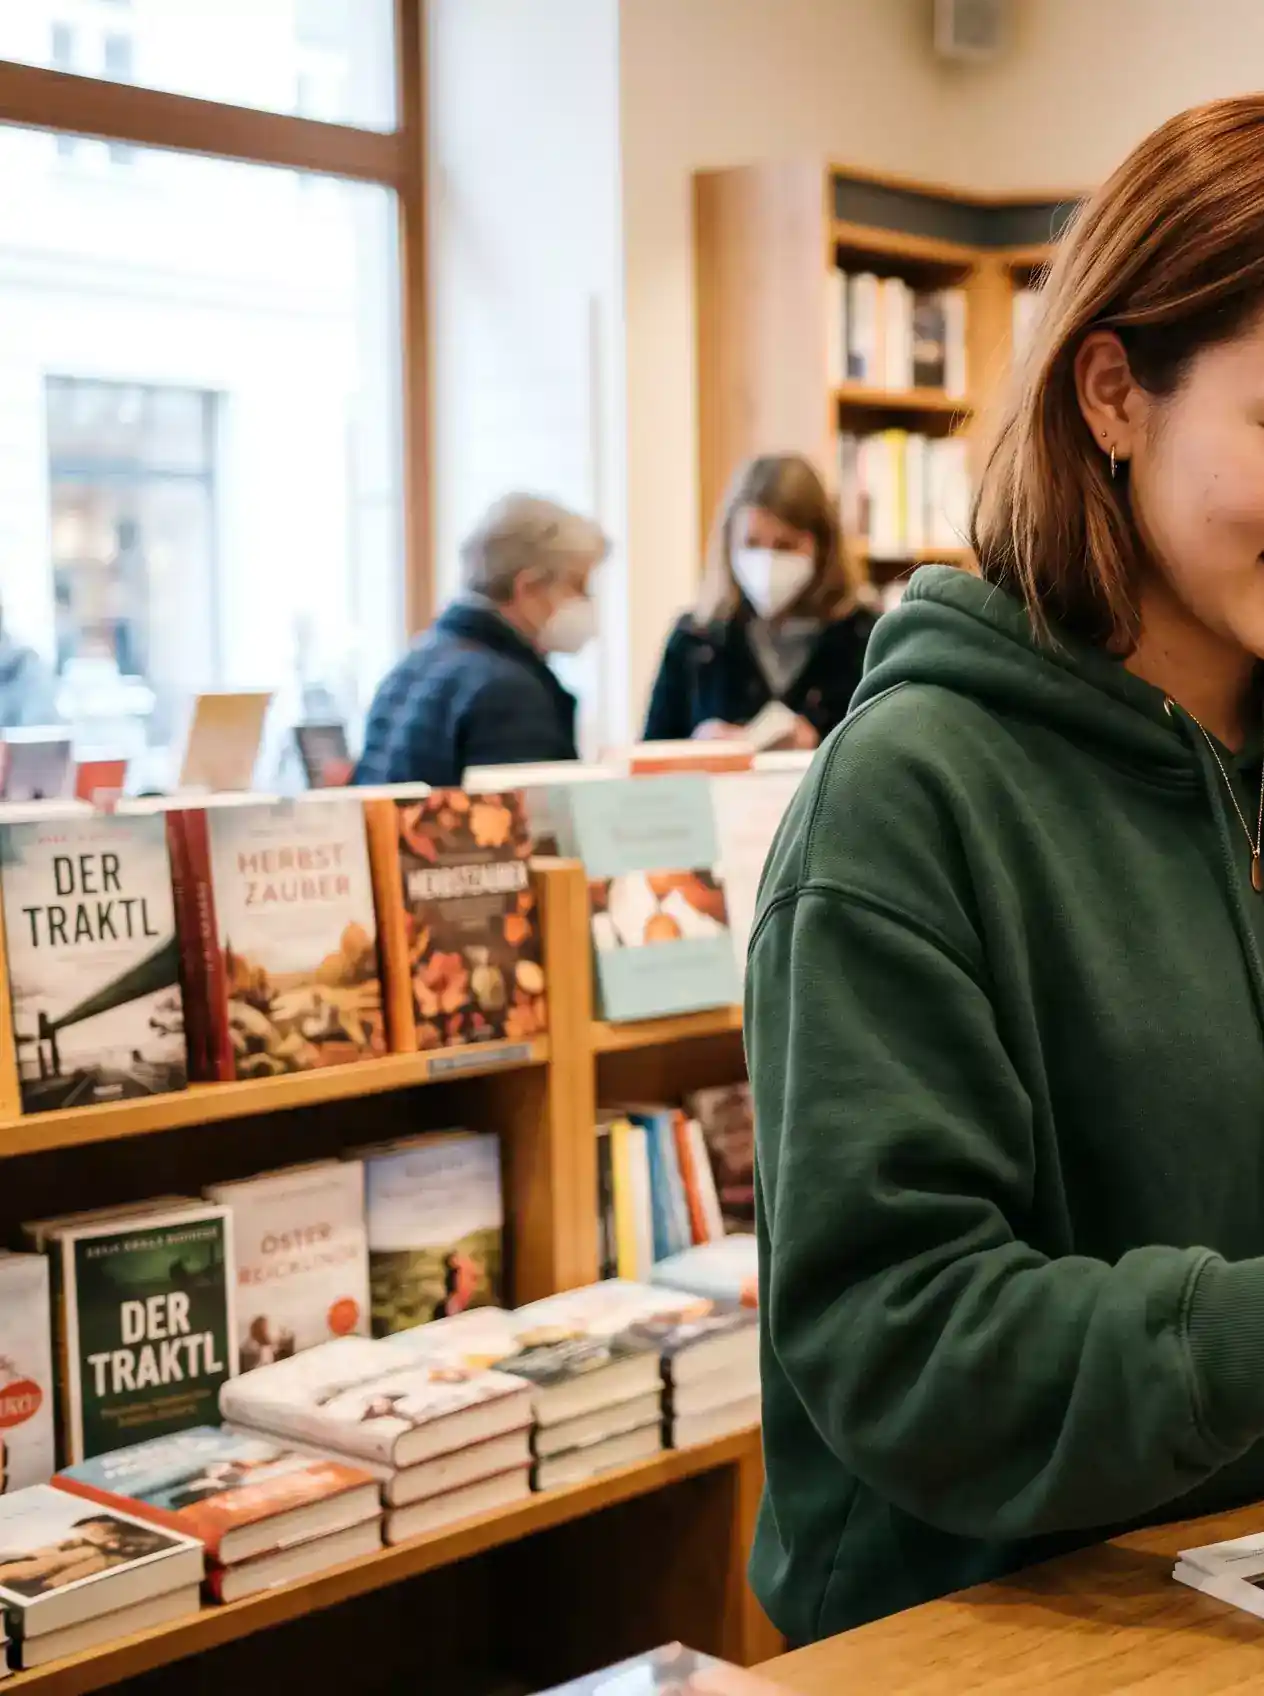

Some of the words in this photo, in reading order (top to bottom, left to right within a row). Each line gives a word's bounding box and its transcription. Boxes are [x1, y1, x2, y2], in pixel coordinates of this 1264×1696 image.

[53, 852, 122, 896] DER
[244, 873, 350, 907] ZAUBER
[22, 897, 160, 947] TRAKTL
[120, 1291, 191, 1345] DER
[87, 1331, 224, 1397] TRAKTL
